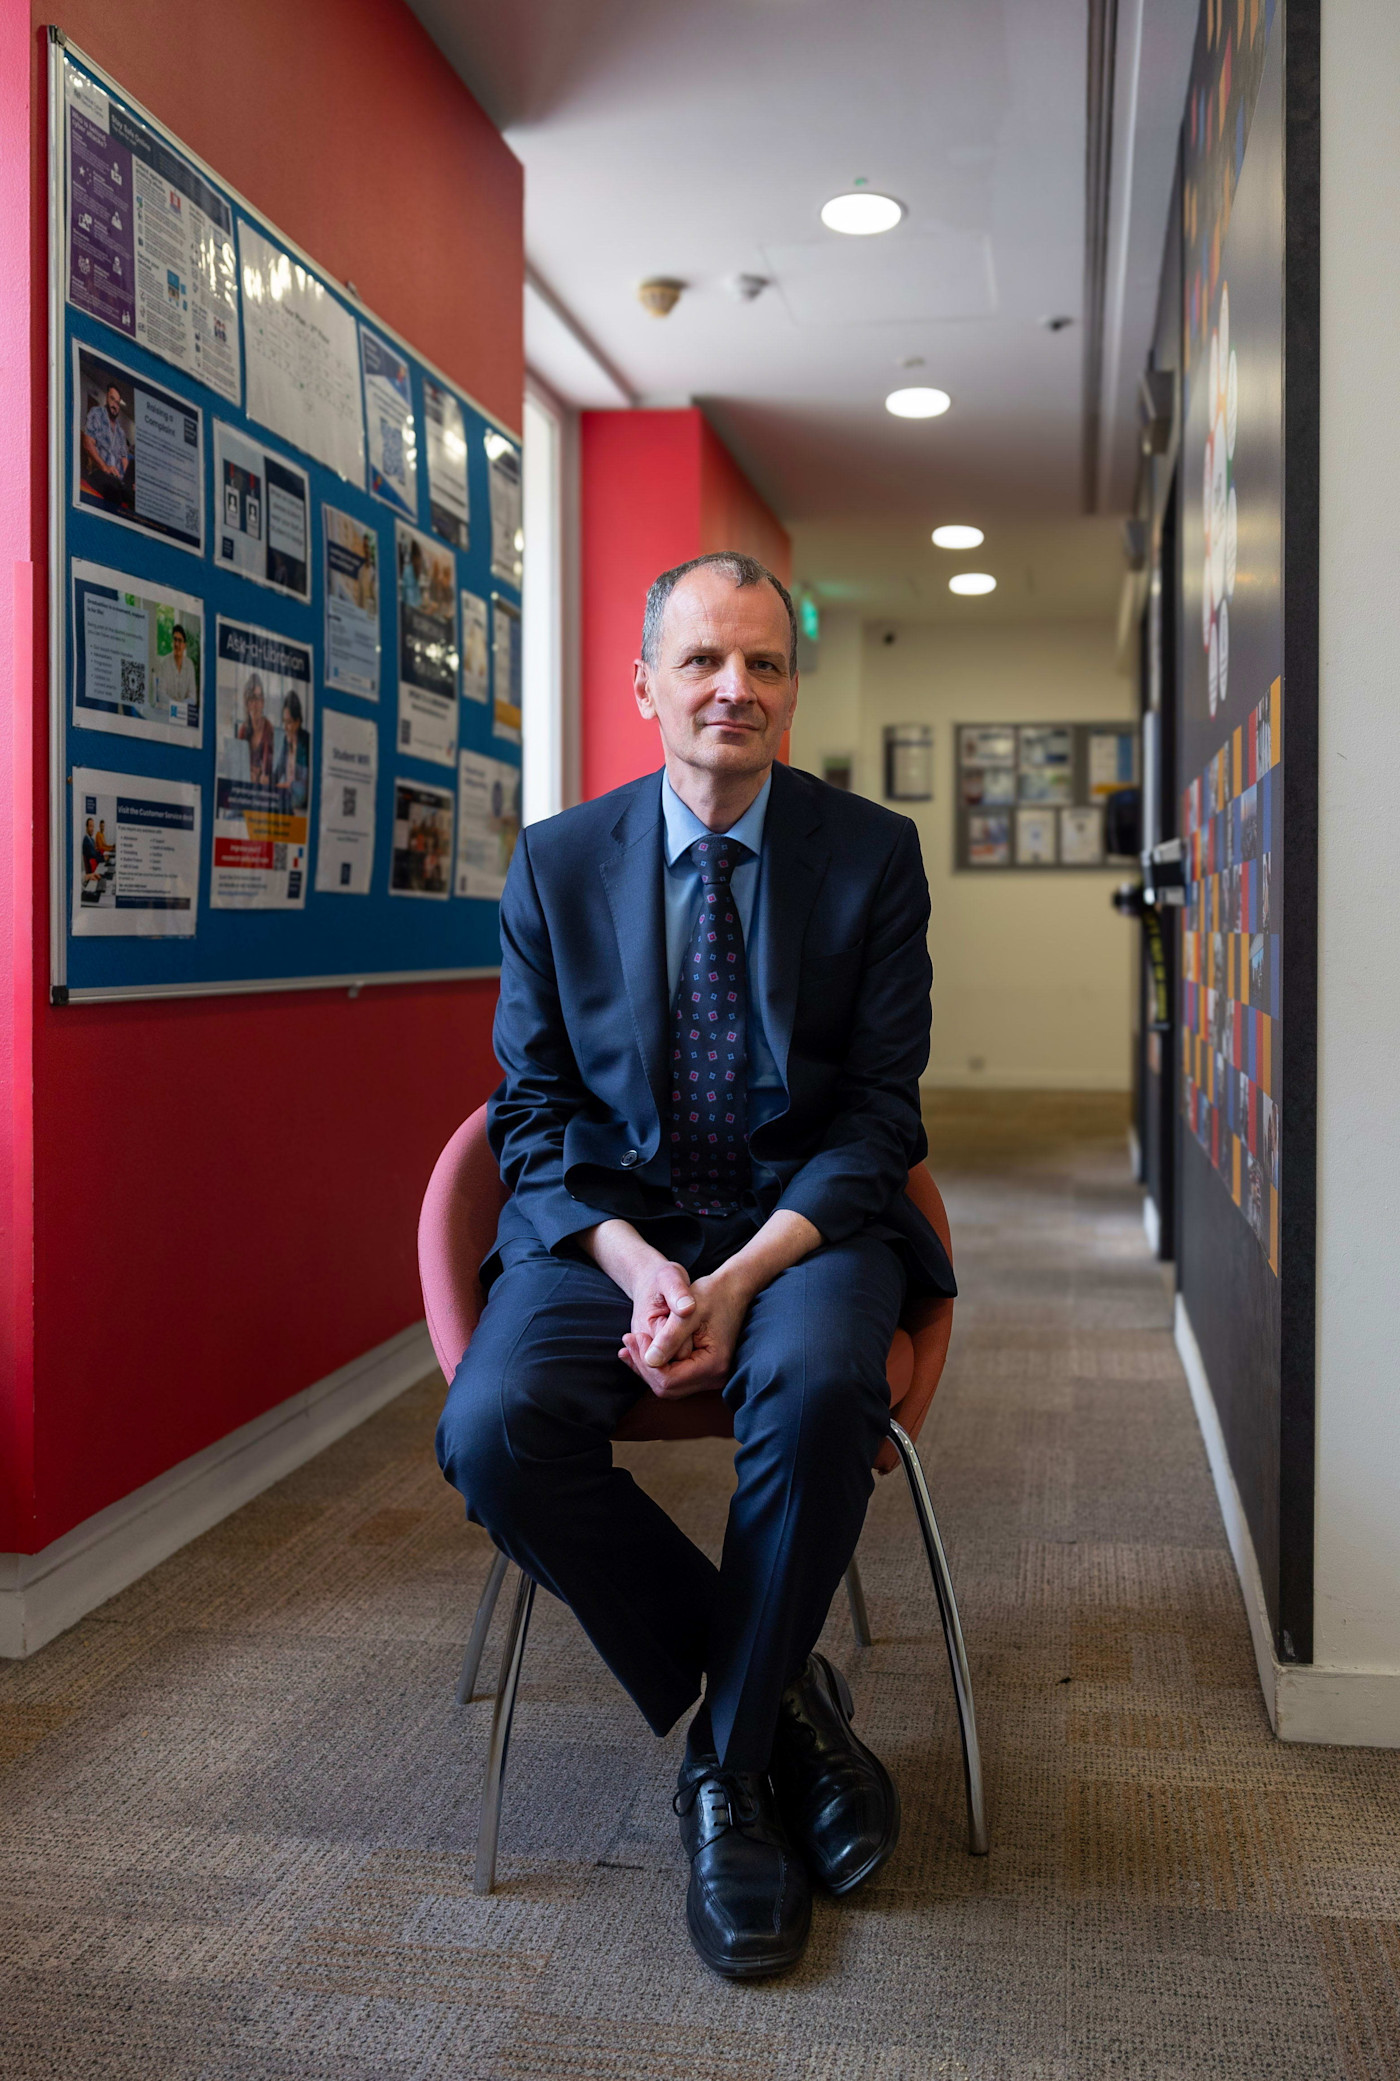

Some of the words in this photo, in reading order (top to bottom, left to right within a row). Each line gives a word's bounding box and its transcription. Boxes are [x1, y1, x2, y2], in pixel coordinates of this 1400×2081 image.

[146, 401, 169, 422] Raising
[144, 414, 176, 437] Complaint
[226, 632, 305, 672] Ask-a-Librarian
[117, 805, 130, 815] Visit
[129, 807, 139, 816] the
[139, 808, 165, 819] Customer
